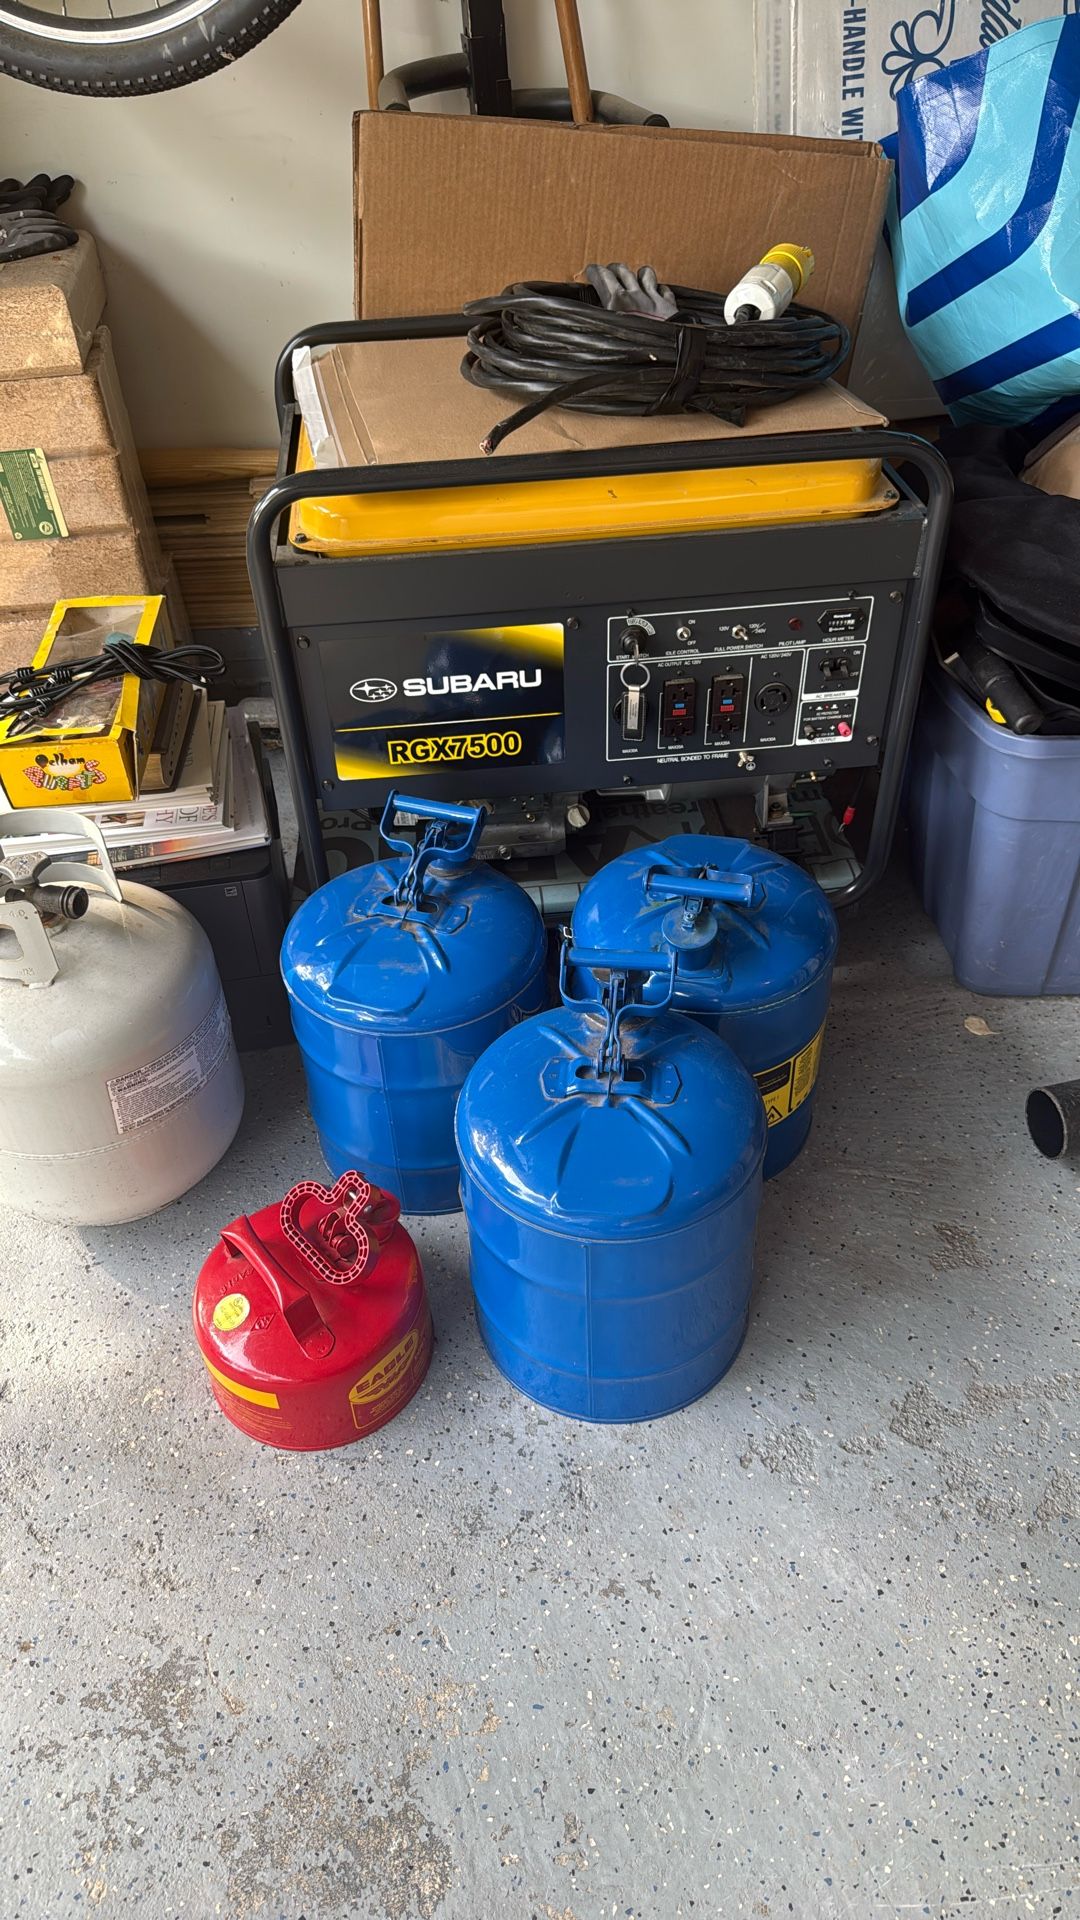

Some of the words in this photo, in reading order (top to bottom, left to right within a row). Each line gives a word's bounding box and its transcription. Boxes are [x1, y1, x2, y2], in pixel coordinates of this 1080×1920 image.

[842, 107, 864, 140] WI
[402, 669, 542, 697] SUBARU
[387, 731, 522, 765] RGX7500
[355, 1335, 414, 1394] EAGLE
